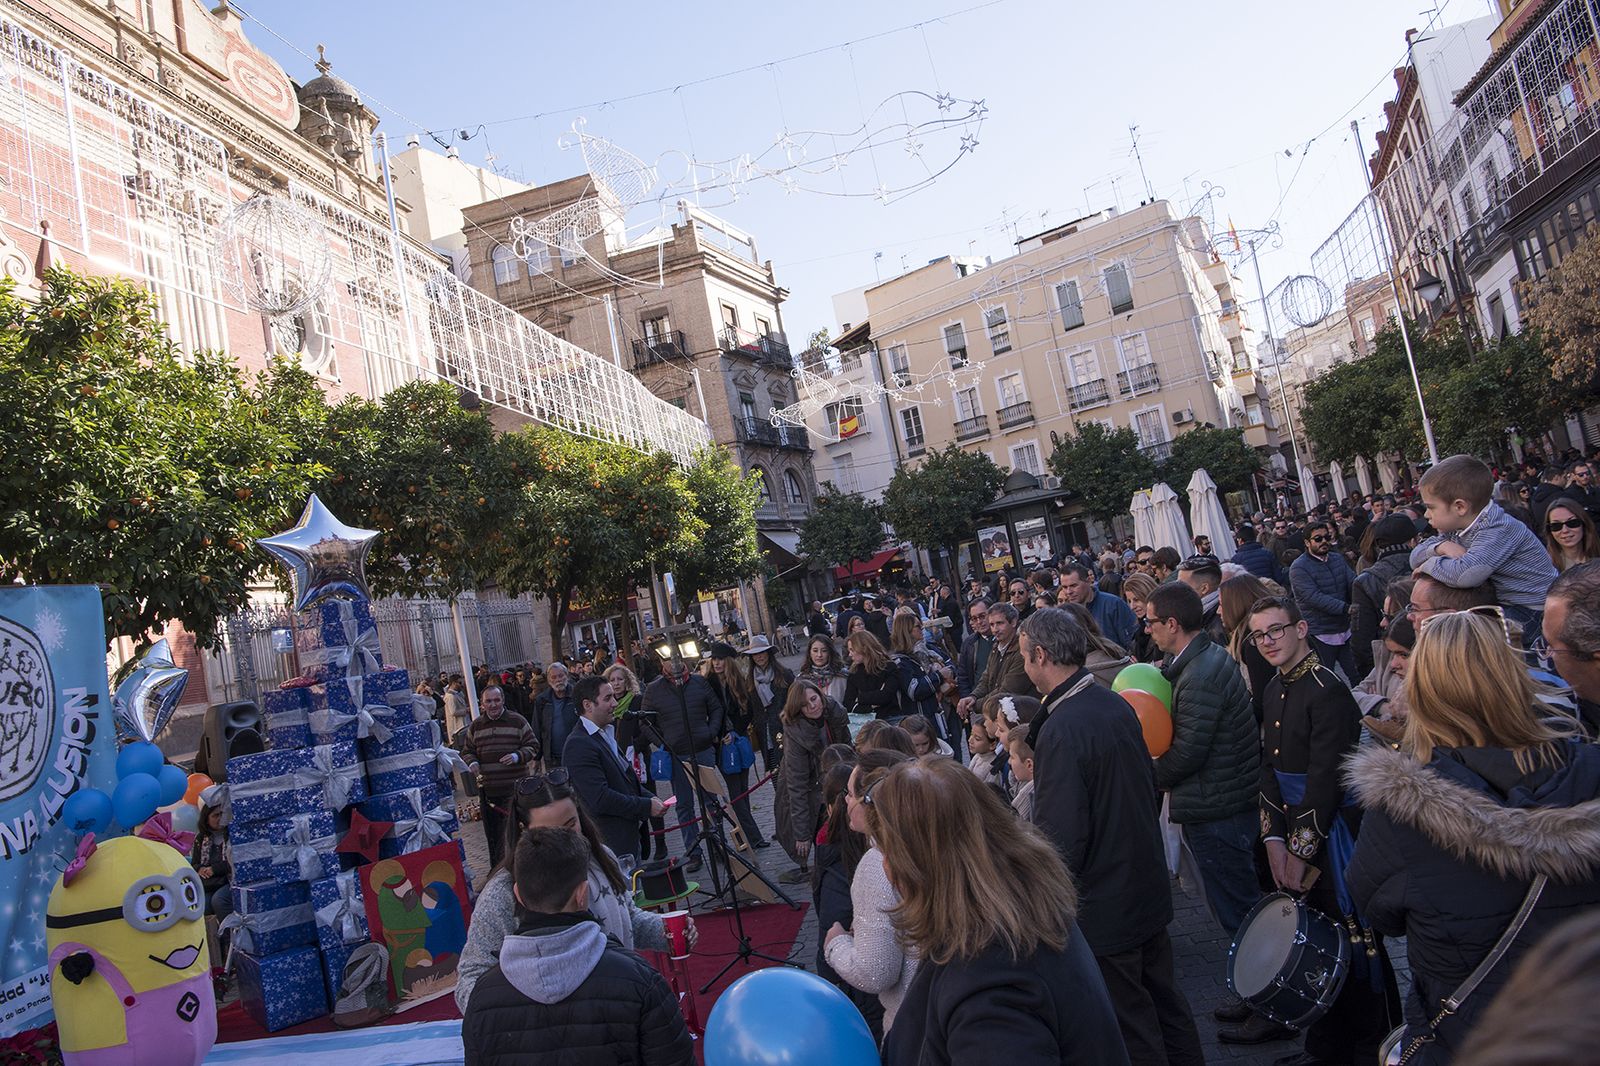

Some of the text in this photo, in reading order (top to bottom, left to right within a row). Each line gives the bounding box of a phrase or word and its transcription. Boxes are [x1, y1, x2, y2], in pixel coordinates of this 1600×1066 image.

[39, 687, 92, 824] ILUSION
[5, 1012, 14, 1020] de
[15, 1006, 26, 1015] las
[27, 995, 51, 1009] Penas
